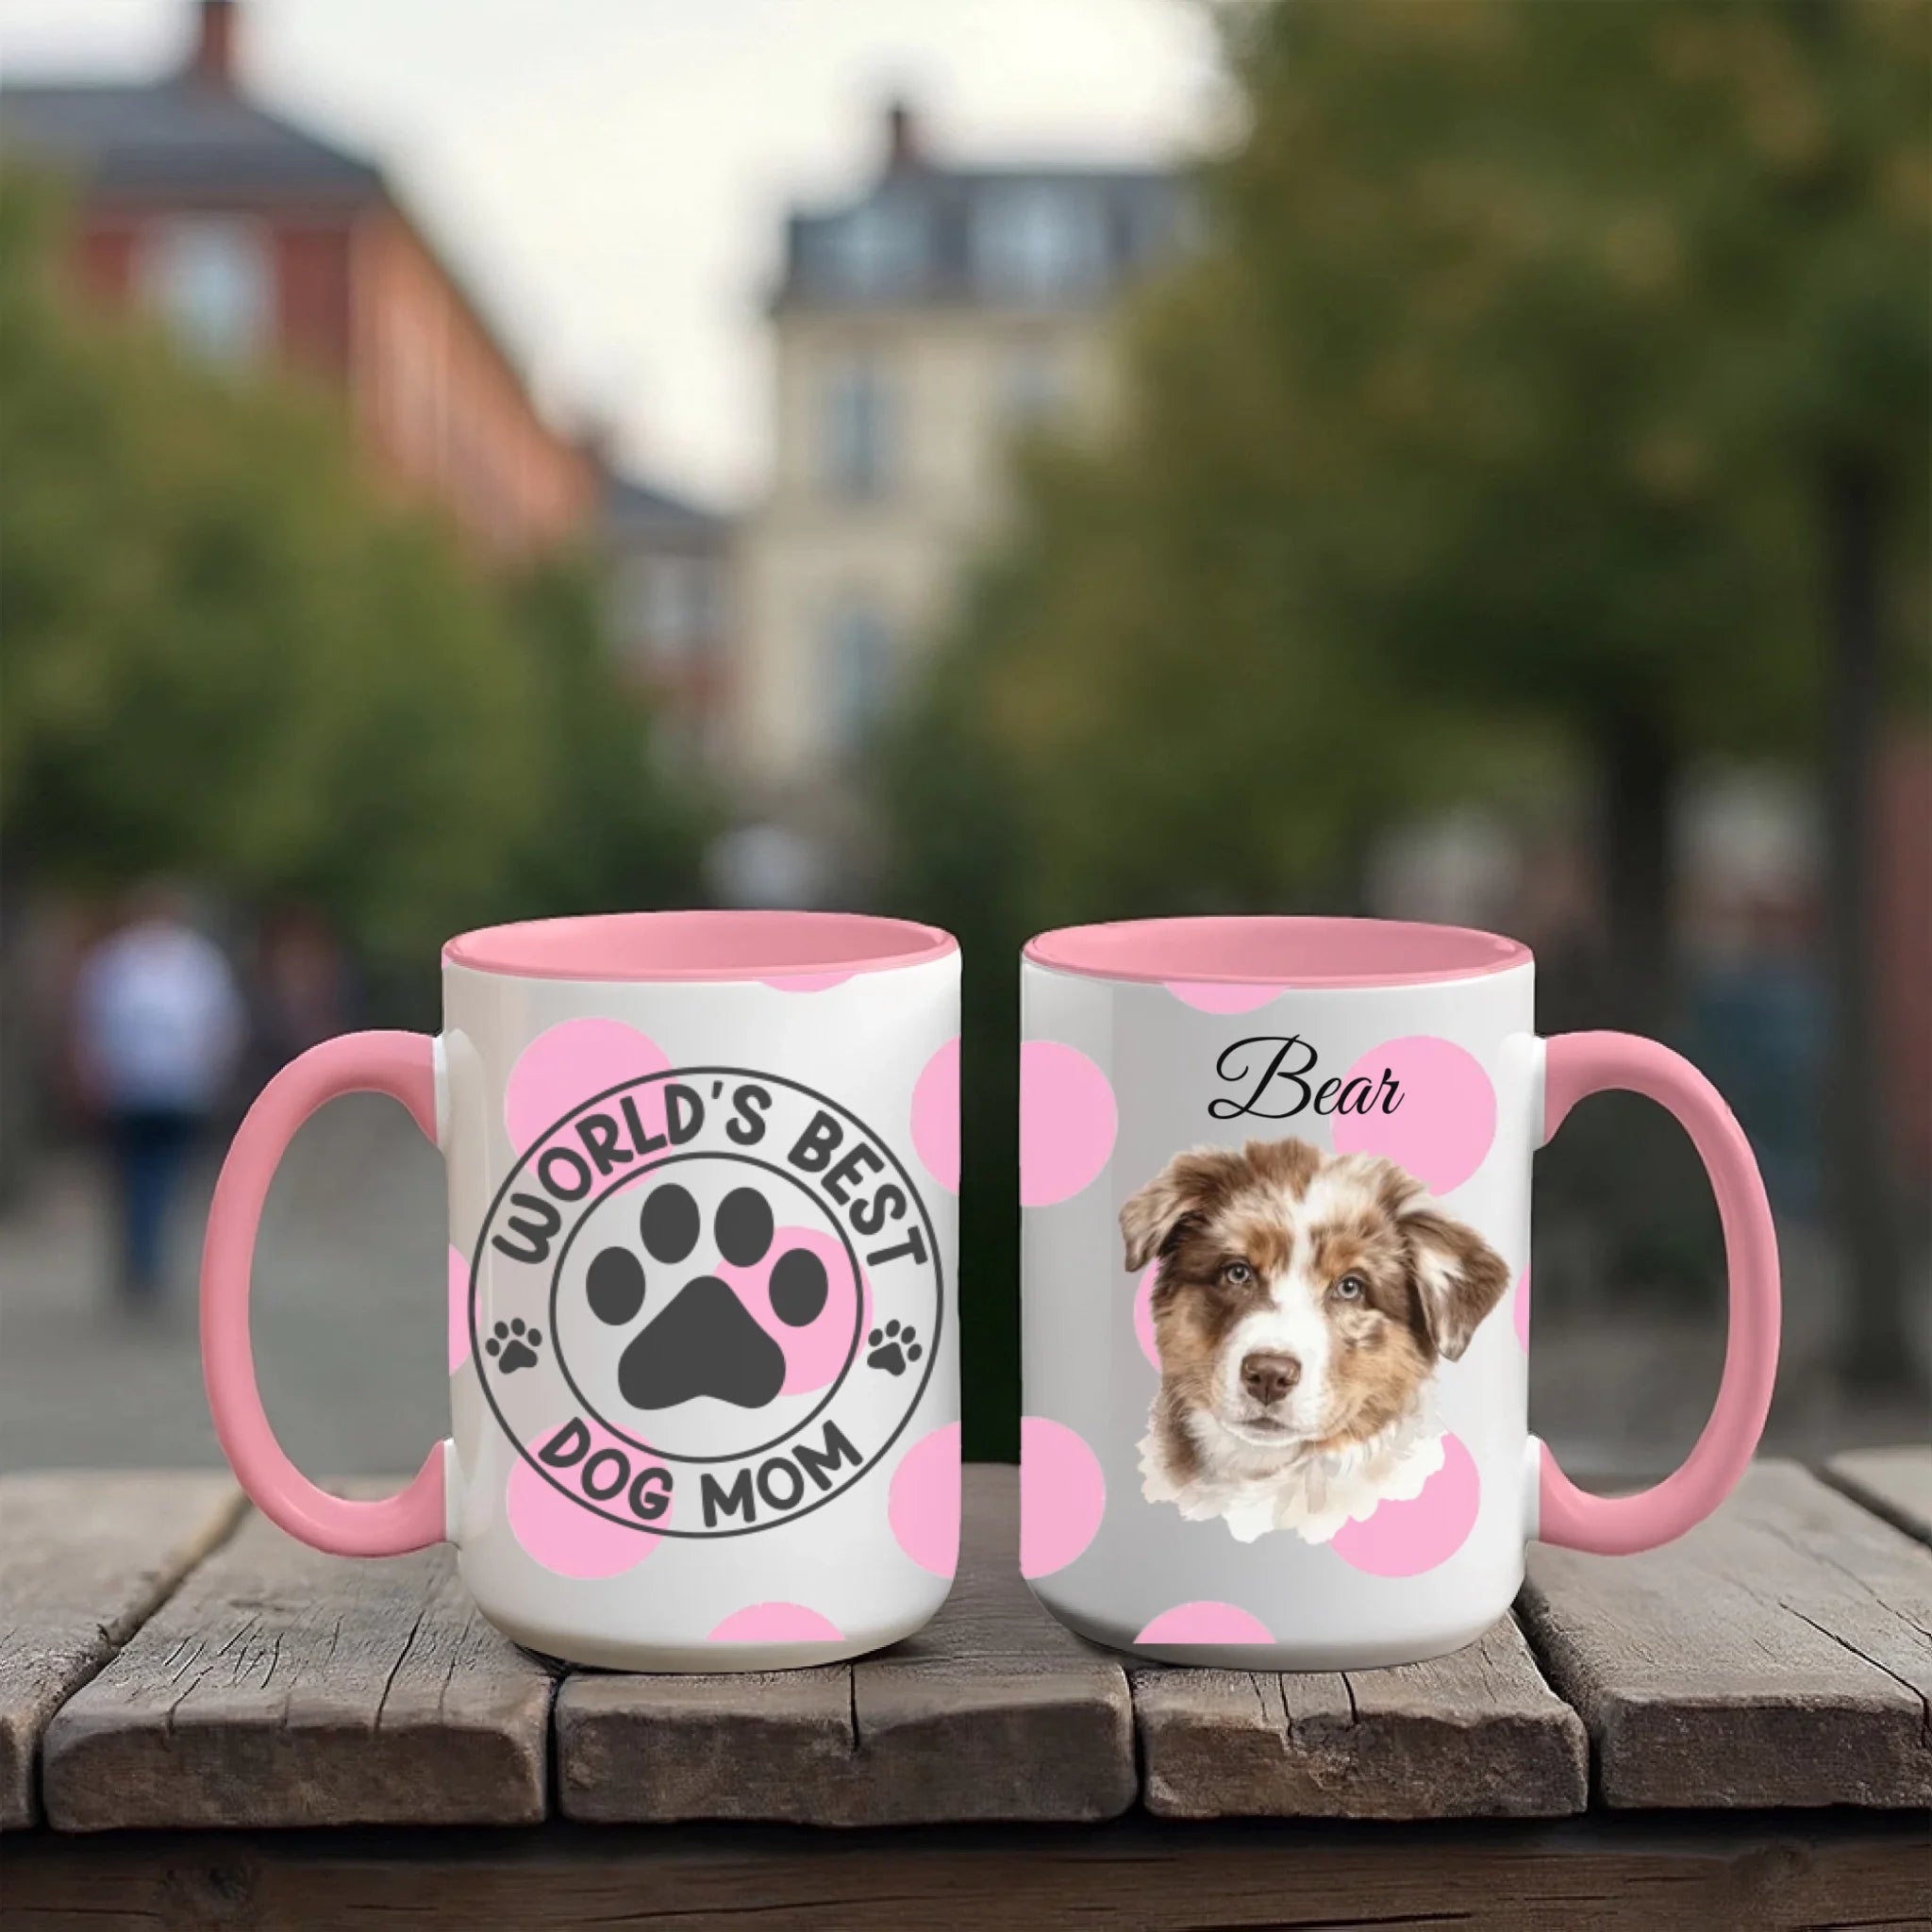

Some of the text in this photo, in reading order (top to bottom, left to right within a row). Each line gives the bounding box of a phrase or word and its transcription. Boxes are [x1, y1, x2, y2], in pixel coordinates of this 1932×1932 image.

[1208, 1034, 1405, 1120] Bear
[491, 1080, 928, 1267] WORLD'S BEST
[538, 1417, 863, 1527] DOG MOM
